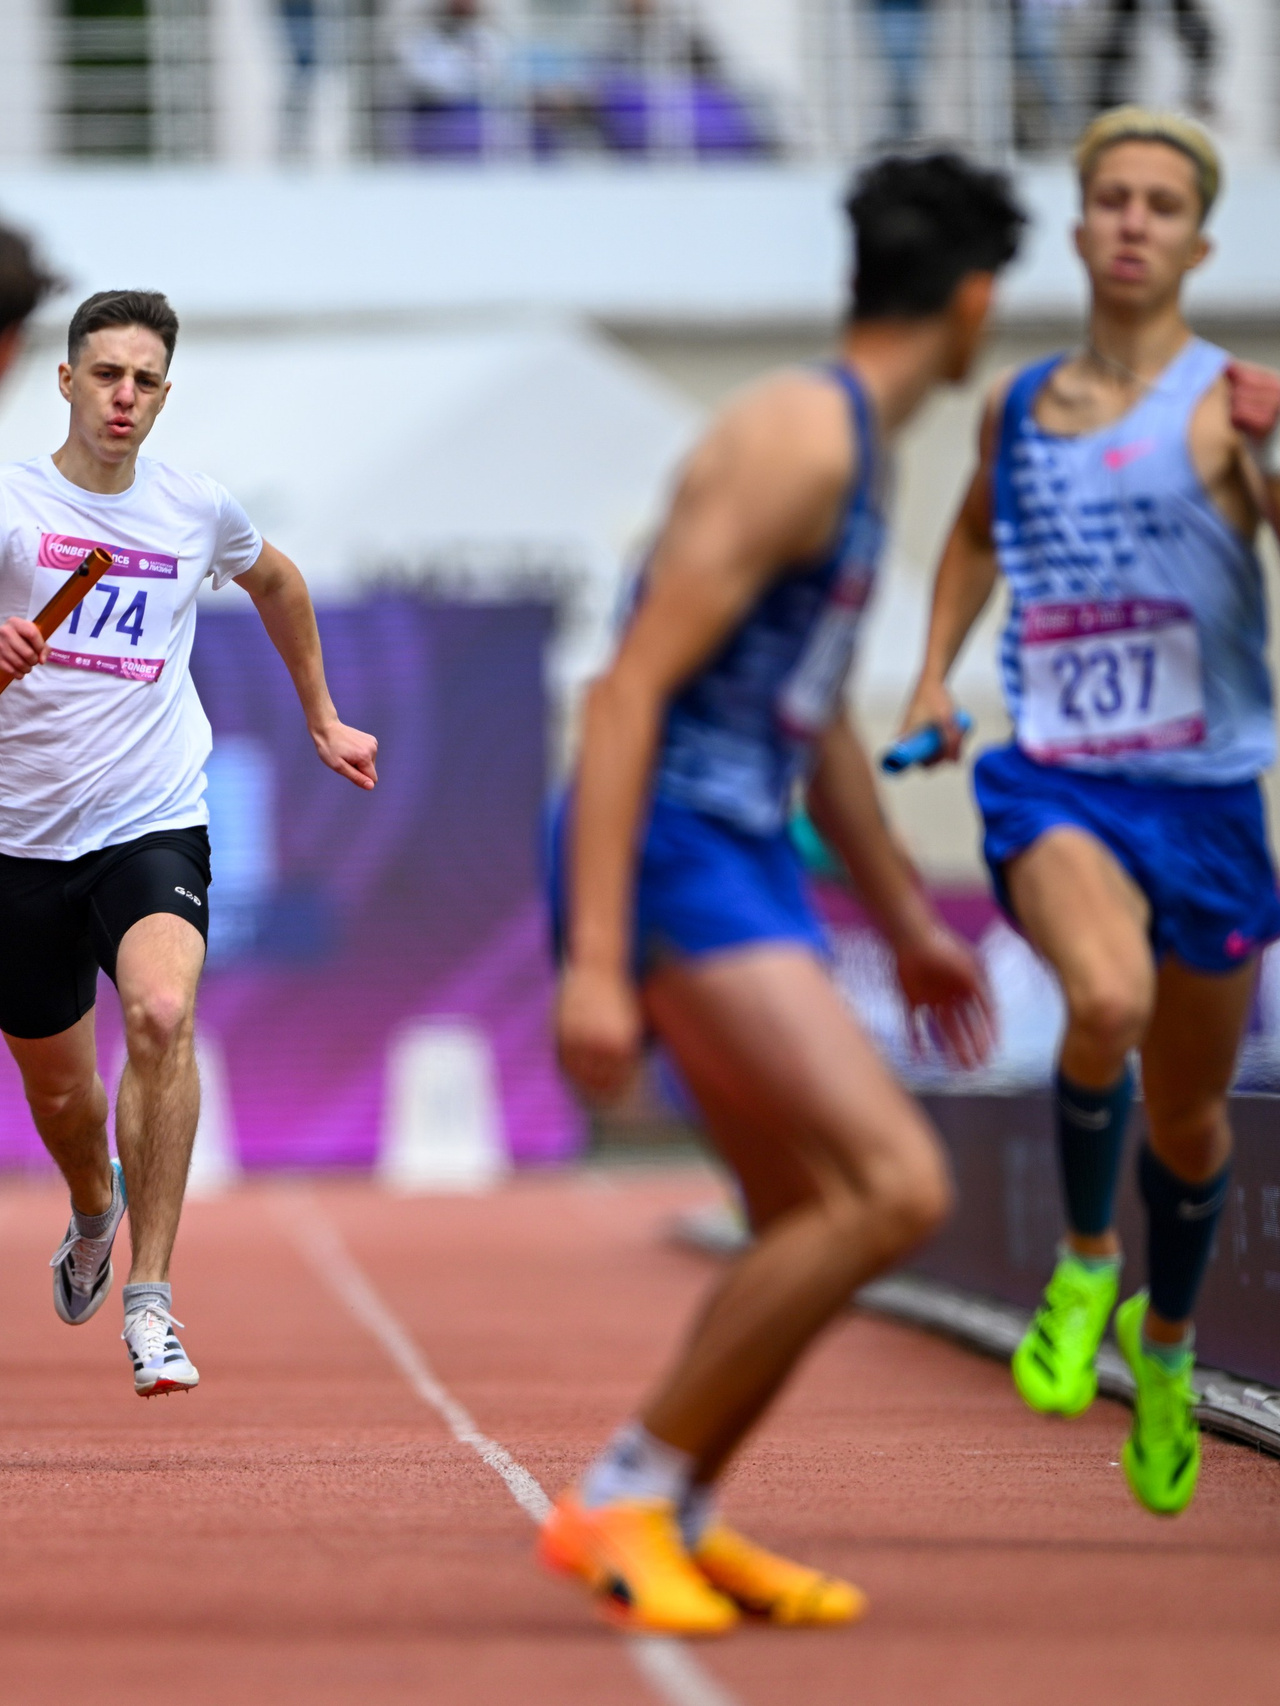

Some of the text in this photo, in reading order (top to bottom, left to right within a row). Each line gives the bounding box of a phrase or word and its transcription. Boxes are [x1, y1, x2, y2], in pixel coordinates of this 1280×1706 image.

[49, 543, 92, 558] FONBET
[112, 553, 130, 565] ПСБ
[149, 565, 173, 574] ЛИЗИНГ
[121, 661, 159, 674] FONBET
[1053, 645, 1155, 722] 237
